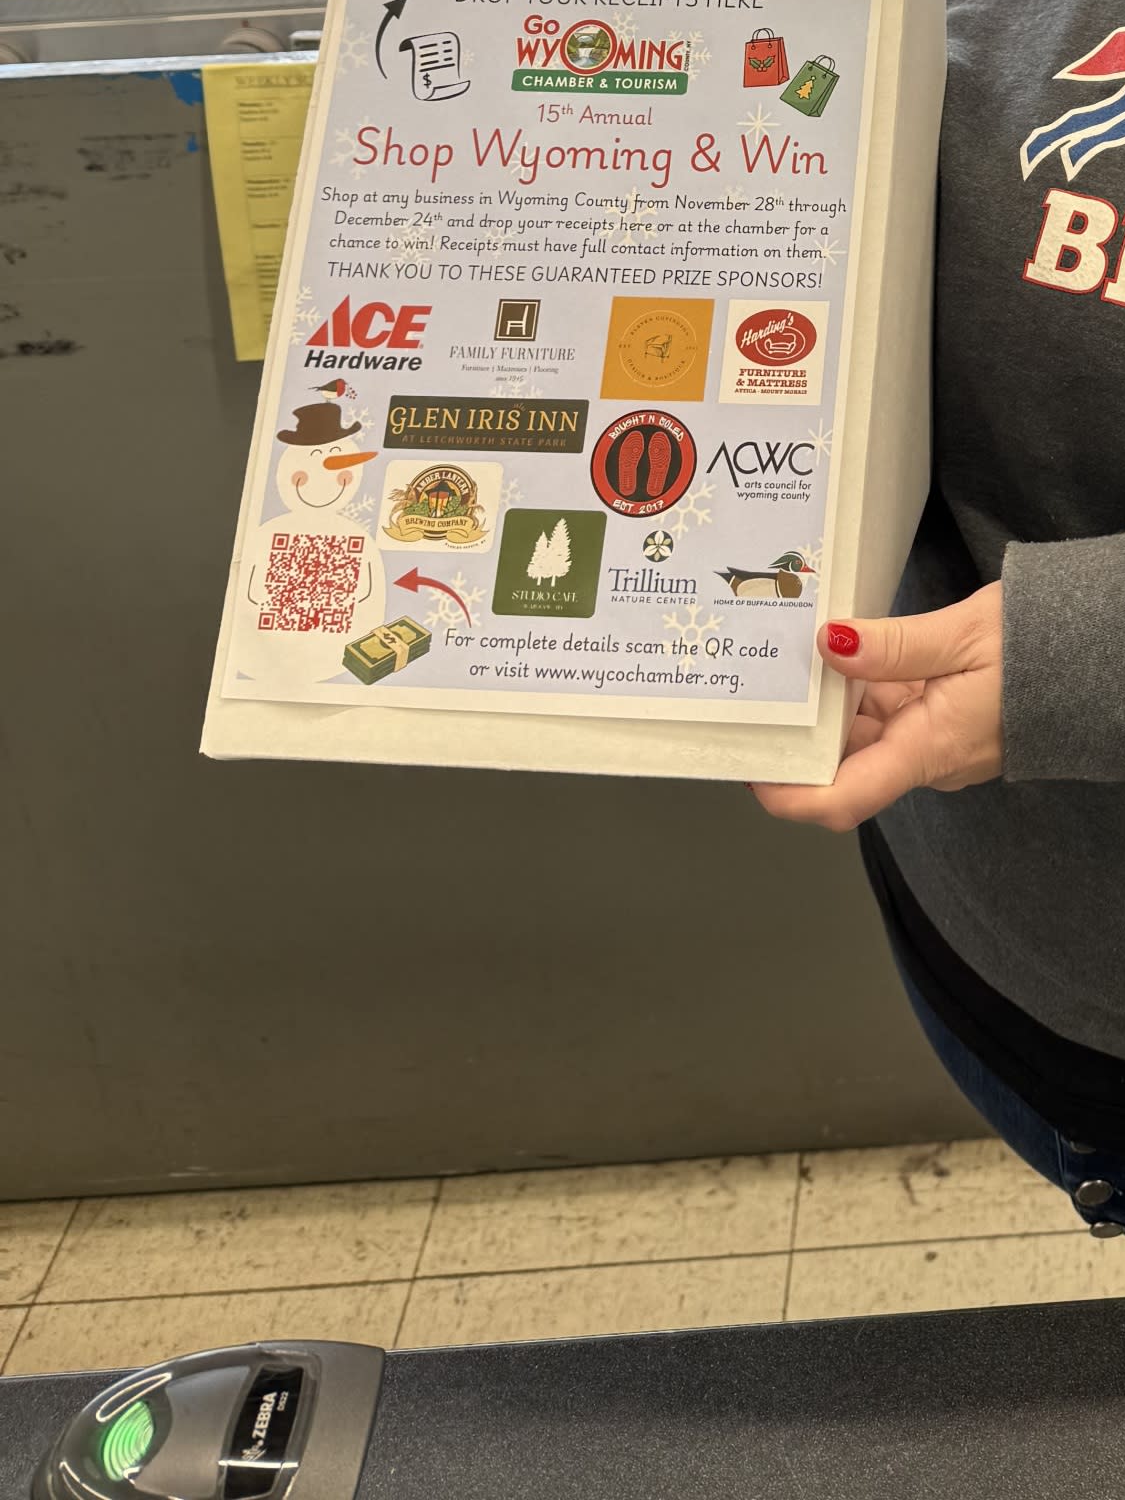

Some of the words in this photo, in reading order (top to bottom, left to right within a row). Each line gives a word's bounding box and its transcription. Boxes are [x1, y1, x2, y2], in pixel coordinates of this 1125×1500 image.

[524, 15, 560, 35] Go
[516, 19, 685, 76] WYOMING
[523, 76, 593, 88] CHAMBER
[600, 78, 608, 88] &
[615, 78, 677, 90] TOURISM
[537, 104, 573, 122] 15th
[578, 105, 652, 126] Annual
[353, 126, 454, 183] Shop
[472, 127, 672, 189] Wyoming
[690, 133, 720, 173] &
[741, 134, 828, 174] Win
[321, 187, 358, 207] Shop
[364, 191, 378, 202] at
[382, 193, 409, 209] any
[414, 189, 474, 204] business
[479, 192, 492, 204] in
[498, 190, 568, 211] Wyoming
[575, 192, 628, 213] County
[632, 193, 669, 213] from
[675, 194, 750, 210] November
[754, 196, 784, 211] 28th
[789, 198, 846, 218] through
[334, 210, 409, 226] December
[412, 212, 443, 227] 24th
[447, 213, 474, 228] and
[480, 214, 512, 234] drop
[518, 220, 553, 234] your
[556, 218, 614, 235] receipts
[619, 217, 652, 232] here
[657, 223, 673, 232] or
[678, 221, 692, 232] at
[698, 219, 720, 233] the
[725, 219, 790, 235] chamber
[792, 221, 816, 241] for
[820, 227, 829, 235] a
[330, 233, 380, 249] chance
[385, 238, 399, 249] to
[403, 235, 435, 250] win!
[440, 236, 498, 256] Receipts
[502, 240, 539, 251] must
[544, 237, 577, 252] have
[580, 238, 606, 258] full
[611, 242, 665, 255] contact
[670, 241, 756, 261] information
[764, 248, 781, 258] on
[786, 244, 827, 259] them.
[328, 261, 392, 279] THANK
[395, 264, 432, 280] YOU
[438, 265, 462, 280] TO
[468, 265, 527, 281] THESE
[531, 266, 656, 284] GUARANTEED
[662, 269, 712, 285] PRIZE
[717, 270, 822, 288] SPONSORS!
[305, 294, 433, 349] ACE
[740, 312, 794, 349] Harding's
[304, 350, 422, 371] Hardware
[449, 346, 498, 359] FAMILY
[501, 347, 576, 361] FURNITURE
[739, 369, 806, 377] FURNITURE
[747, 379, 808, 387] MATTRESS
[389, 407, 461, 435] GLEN
[466, 408, 521, 431] IRIS
[527, 410, 579, 432] INN
[608, 415, 646, 440] BOUGHT
[649, 415, 655, 423] N
[401, 435, 416, 443] AT
[419, 435, 495, 445] LETCHWORTH
[500, 437, 532, 446] STATE
[537, 438, 566, 447] PARK
[706, 440, 815, 488] ACWC
[416, 472, 440, 492] AMBER
[443, 471, 470, 495] LANTERN
[764, 480, 796, 489] council
[799, 480, 811, 490] for
[639, 500, 664, 514] 2017
[737, 491, 778, 501] wyoming
[781, 492, 810, 502] county
[405, 518, 435, 527] BREWING
[438, 519, 468, 528] COMPANY
[608, 567, 697, 594] Trillium
[512, 590, 550, 601] STUDIO
[611, 595, 651, 603] NATURE
[657, 597, 696, 605] CENTER
[445, 628, 475, 646] For
[480, 631, 557, 656] complete
[563, 632, 620, 653] details
[625, 642, 665, 654] scan
[672, 637, 698, 655] the
[705, 637, 734, 659] QR
[739, 639, 778, 658] code
[470, 664, 490, 676] or
[495, 661, 530, 678] visit
[535, 663, 744, 694] www.wycochamber.org.
[252, 1392, 277, 1439] ZEBRA
